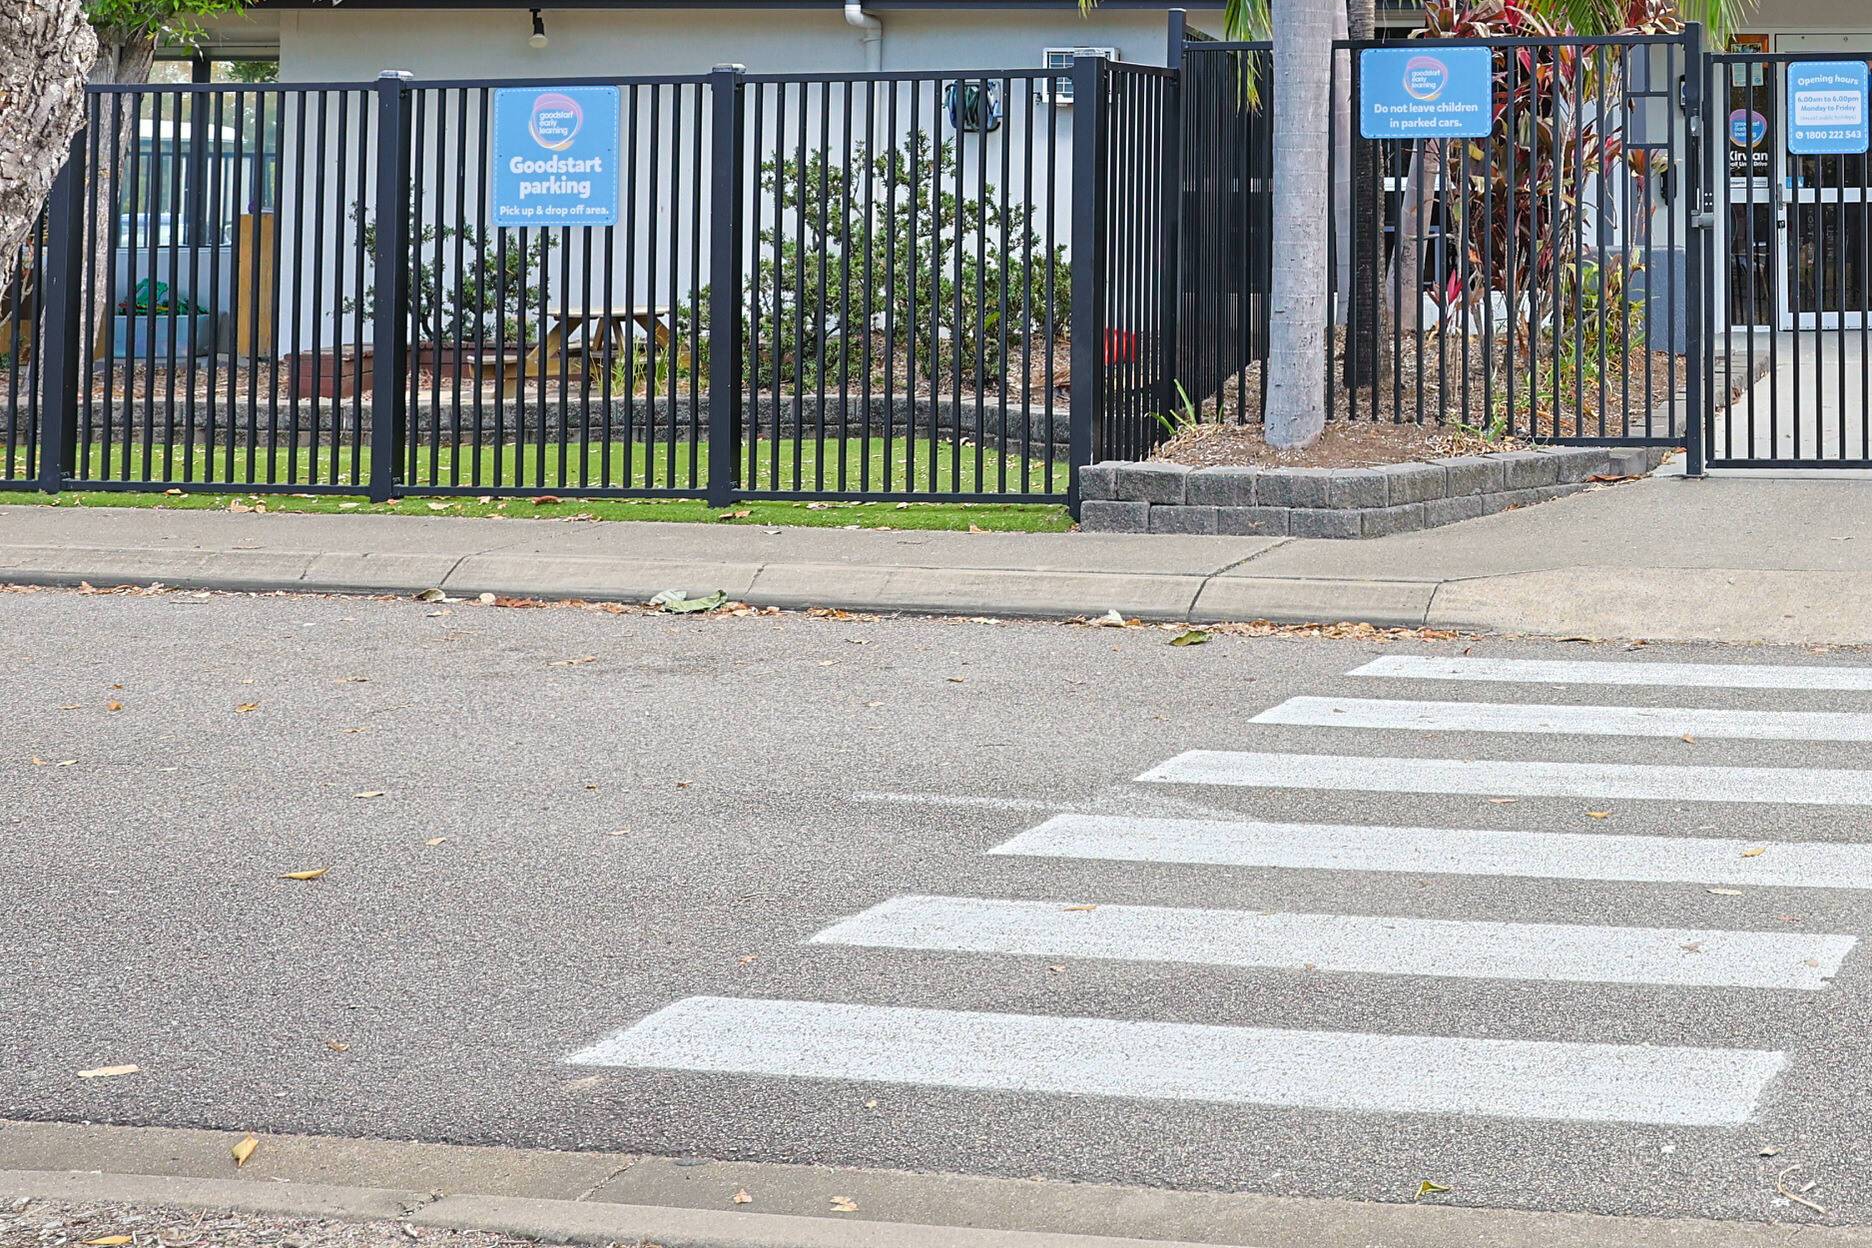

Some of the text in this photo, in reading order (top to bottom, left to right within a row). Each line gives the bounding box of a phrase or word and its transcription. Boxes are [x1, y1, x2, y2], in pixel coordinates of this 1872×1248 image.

[1798, 74, 1858, 86] Opening hours
[1374, 102, 1478, 113] Do not leave children
[1836, 104, 1856, 112] Friday
[539, 111, 574, 120] goodstart
[1390, 118, 1462, 130] in parked cars.
[539, 127, 568, 136] learning
[1828, 131, 1844, 139] 222
[1845, 131, 1862, 139] 543
[509, 154, 603, 174] Goodstart
[519, 176, 591, 199] parking
[500, 205, 609, 217] Pick up & drop off area.
